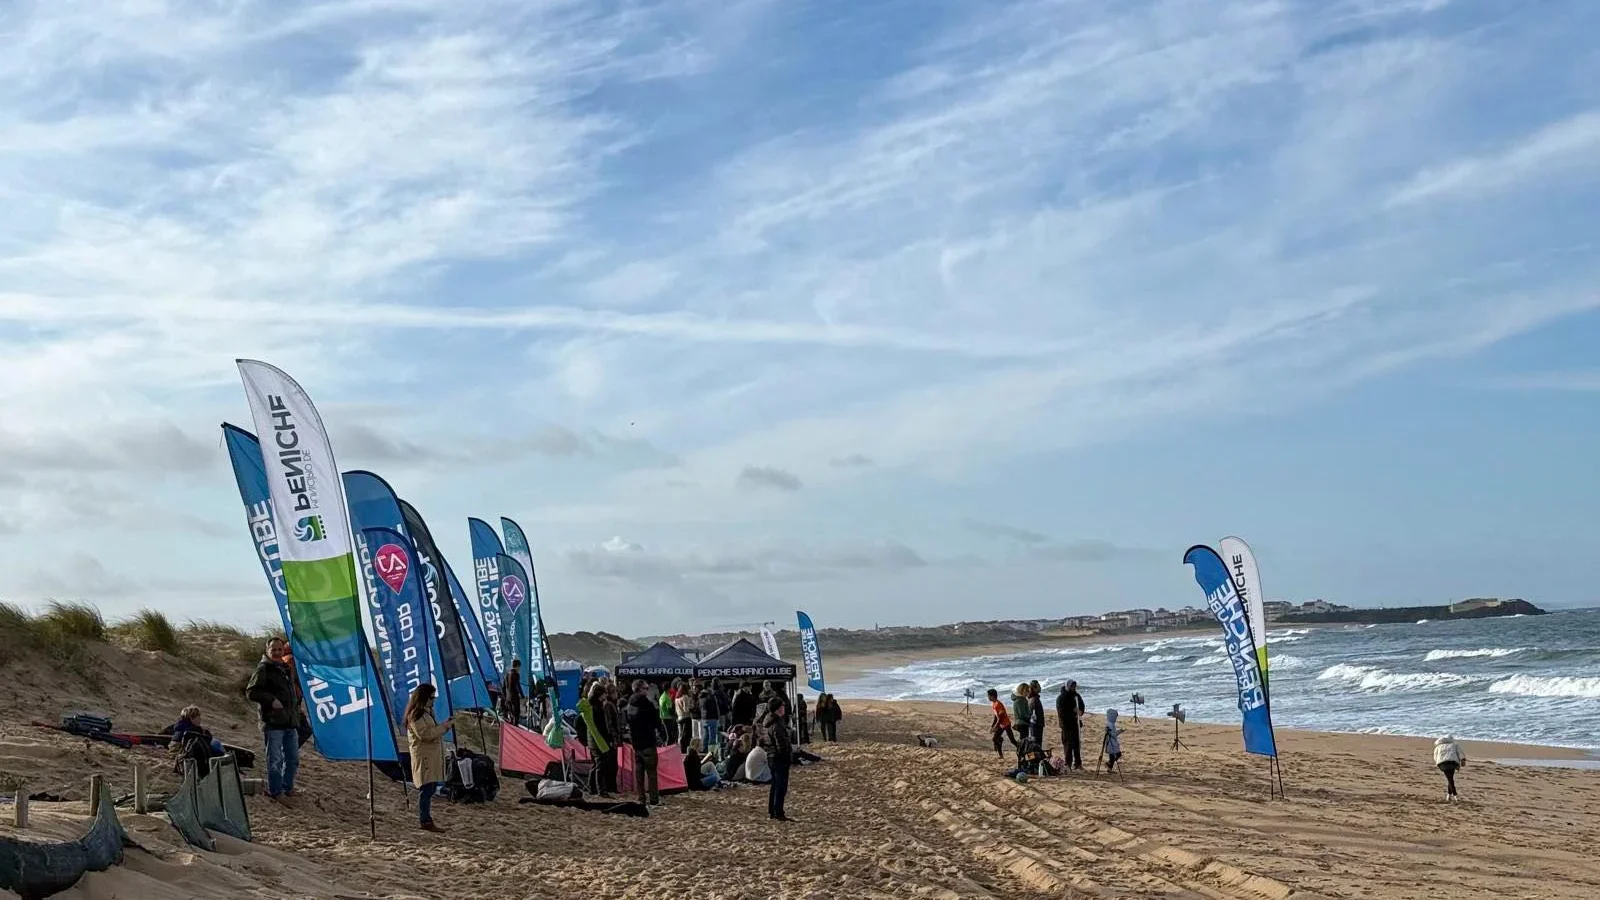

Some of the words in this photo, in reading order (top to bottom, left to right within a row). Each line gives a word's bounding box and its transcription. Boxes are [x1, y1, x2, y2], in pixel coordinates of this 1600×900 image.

[647, 667, 674, 675] SURFING
[732, 668, 764, 676] SURFING
[766, 667, 792, 675] CLUBE
